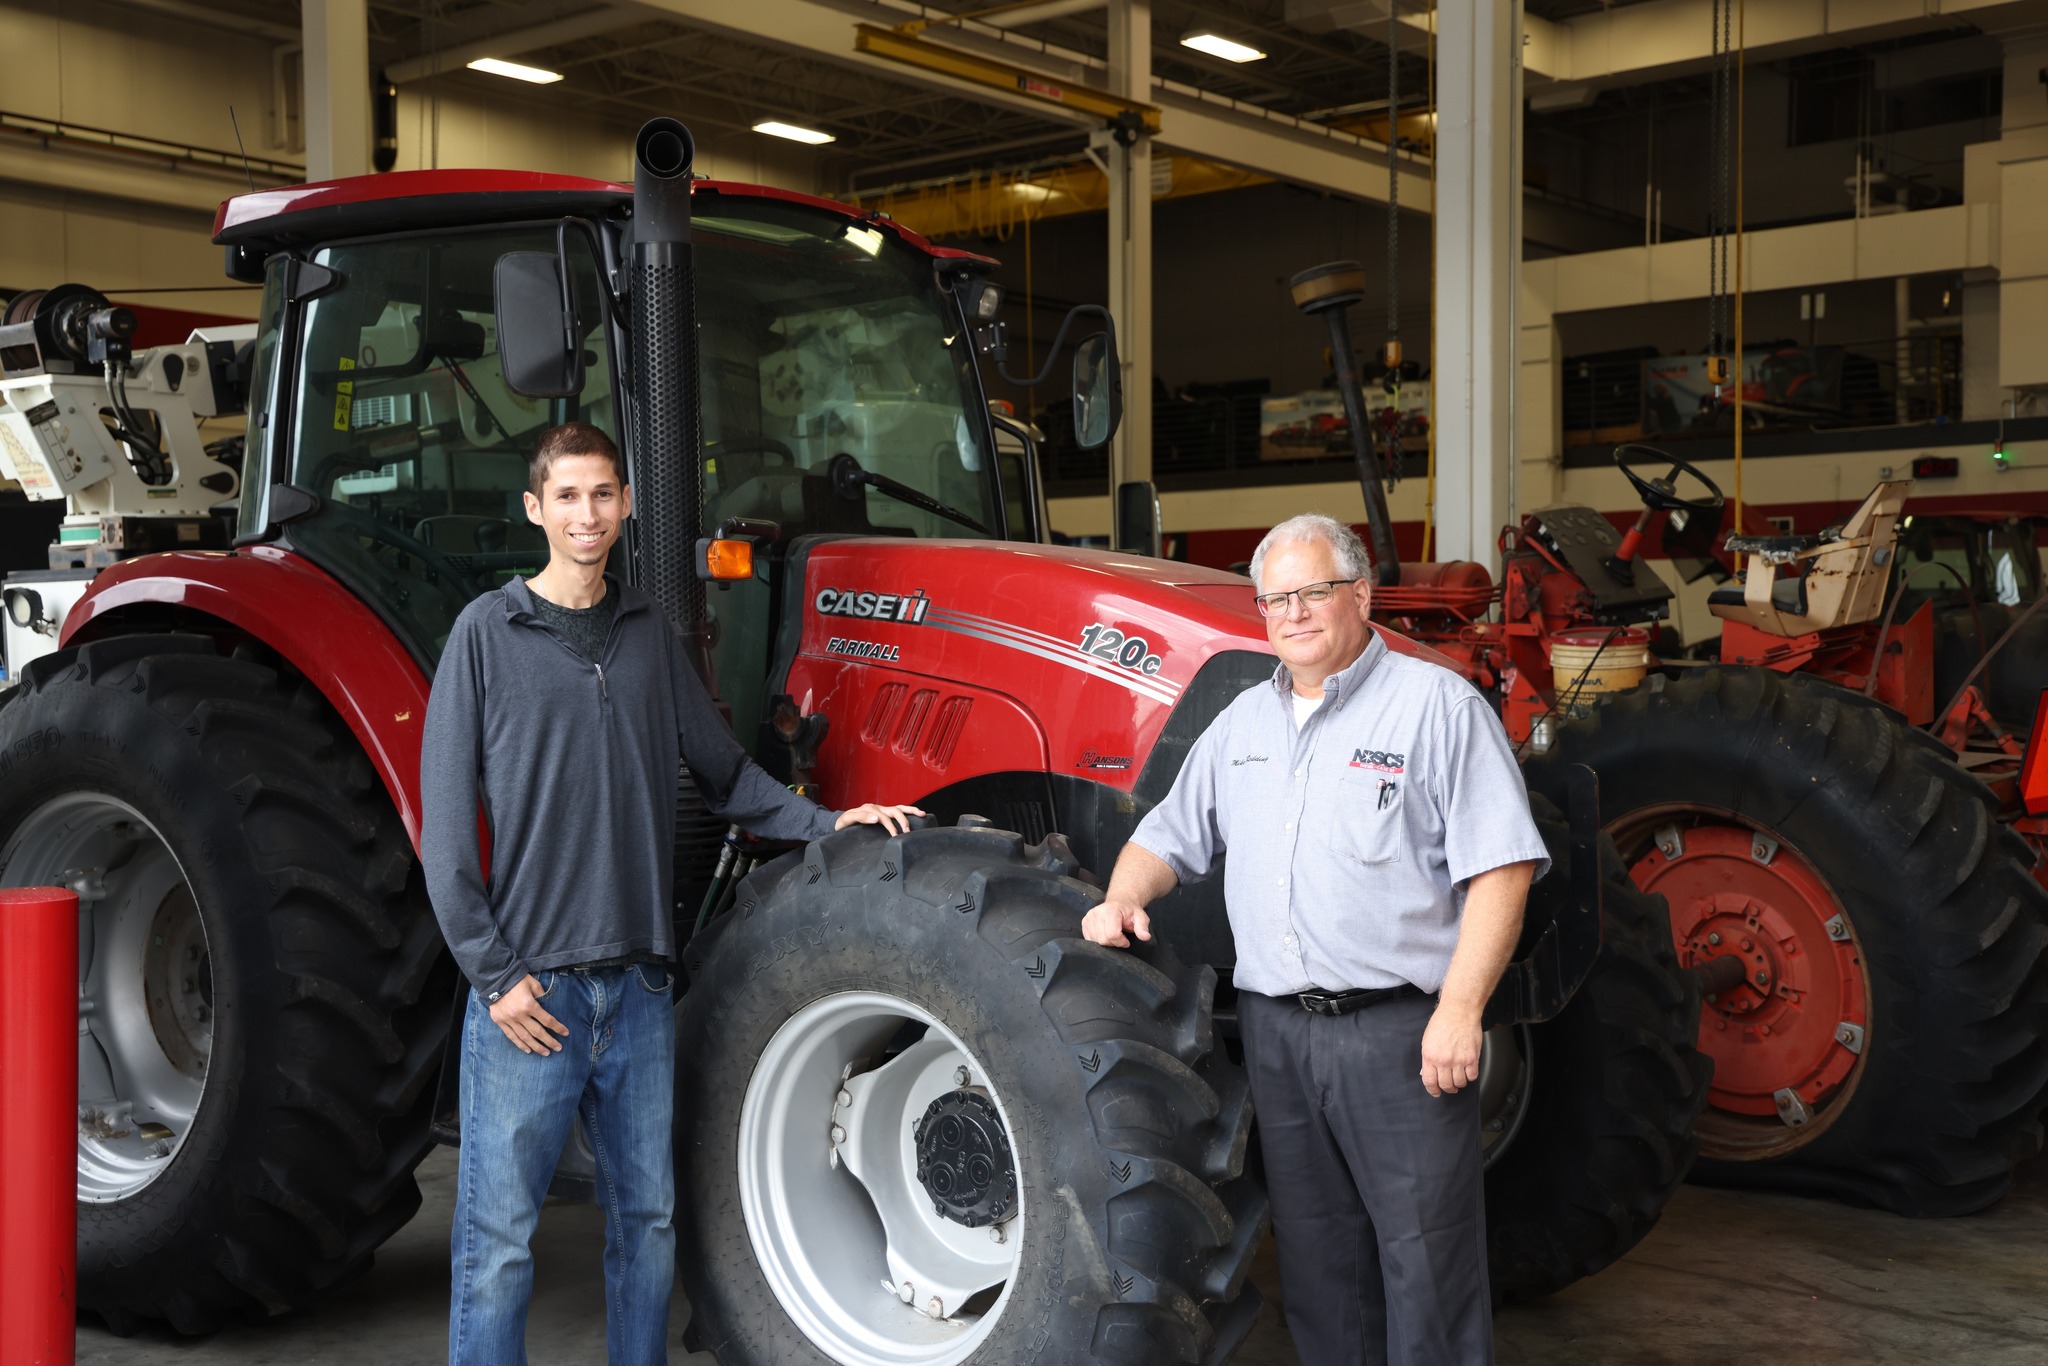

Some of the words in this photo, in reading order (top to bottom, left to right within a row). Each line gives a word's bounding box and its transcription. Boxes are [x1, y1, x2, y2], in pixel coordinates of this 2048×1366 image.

[815, 587, 898, 620] CASE
[825, 637, 900, 662] FARMALL
[700, 920, 830, 1045] LAXY
